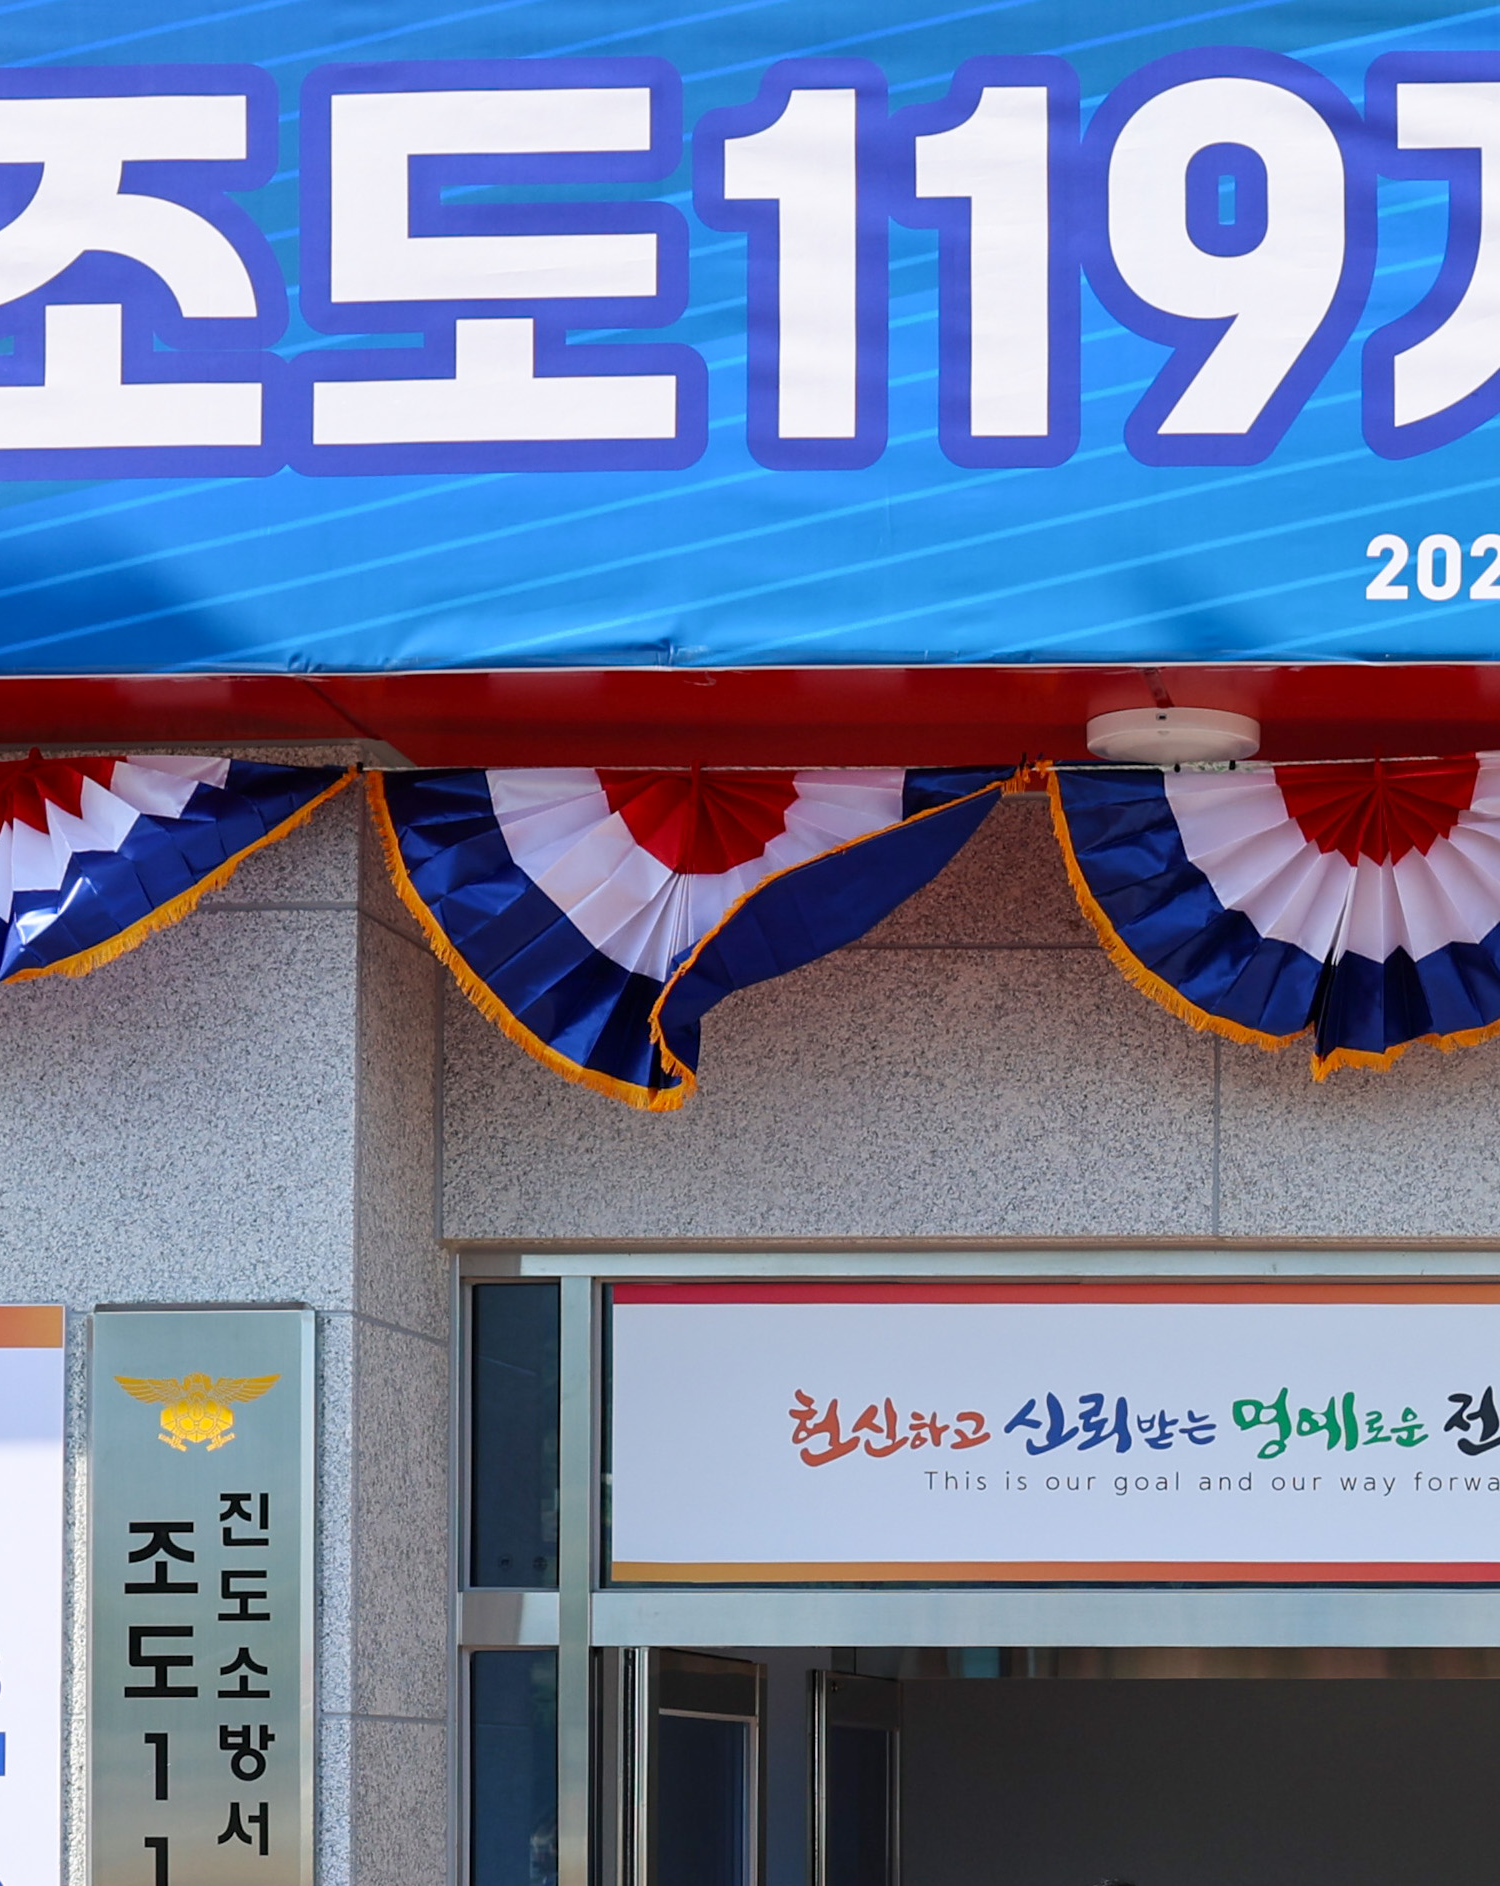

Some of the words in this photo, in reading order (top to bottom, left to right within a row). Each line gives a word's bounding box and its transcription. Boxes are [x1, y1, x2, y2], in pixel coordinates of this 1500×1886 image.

[788, 1389, 992, 1467] 헌신하고
[1003, 1391, 1218, 1456] 신뢰받는
[1232, 1386, 1430, 1460] 명예로운
[924, 1471, 987, 1491] This
[1006, 1470, 1027, 1491] is
[1045, 1476, 1096, 1491] our
[1114, 1471, 1179, 1496] goal
[1199, 1472, 1252, 1491] and
[1271, 1476, 1322, 1491] our
[1340, 1476, 1396, 1497] way
[217, 1491, 276, 1857] 진도소방서
